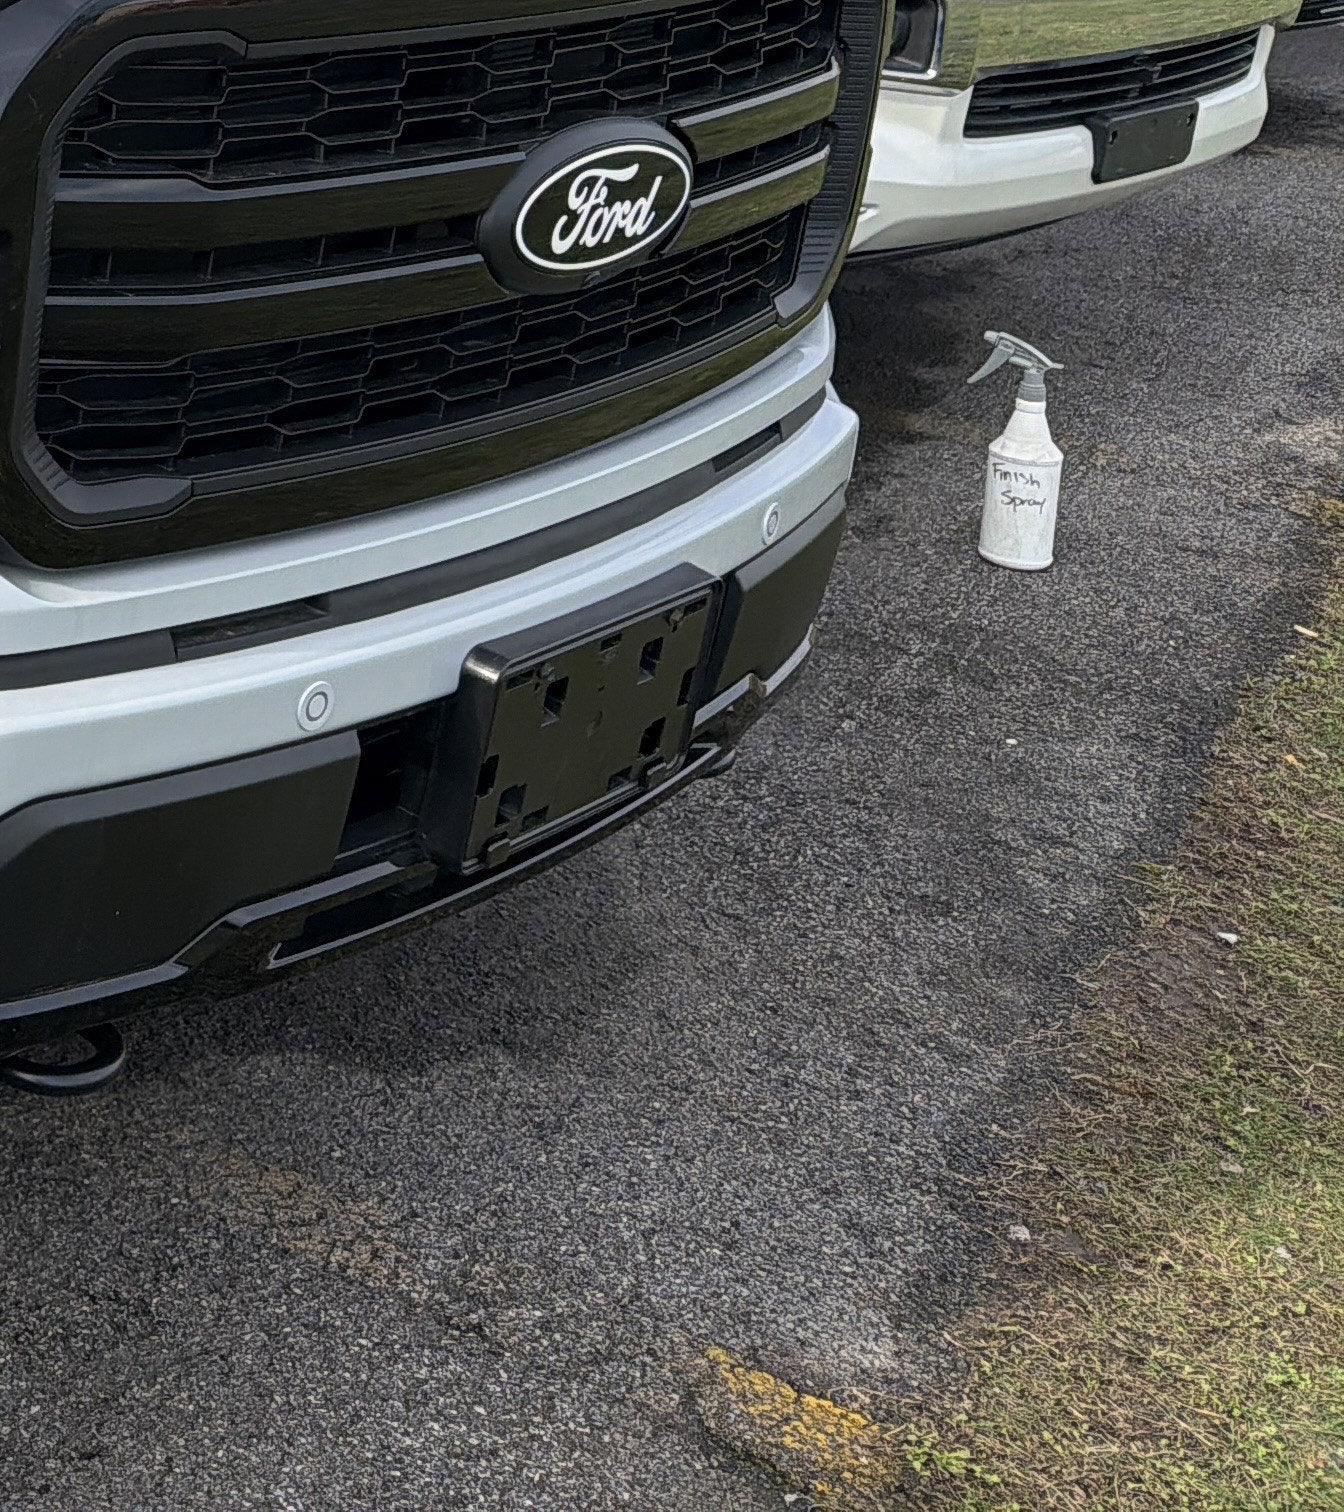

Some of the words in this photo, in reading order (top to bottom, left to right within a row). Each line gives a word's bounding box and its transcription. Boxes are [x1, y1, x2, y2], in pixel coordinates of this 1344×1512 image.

[550, 162, 664, 256] Ford
[991, 462, 1042, 489] Finish
[999, 491, 1047, 515] Spray
